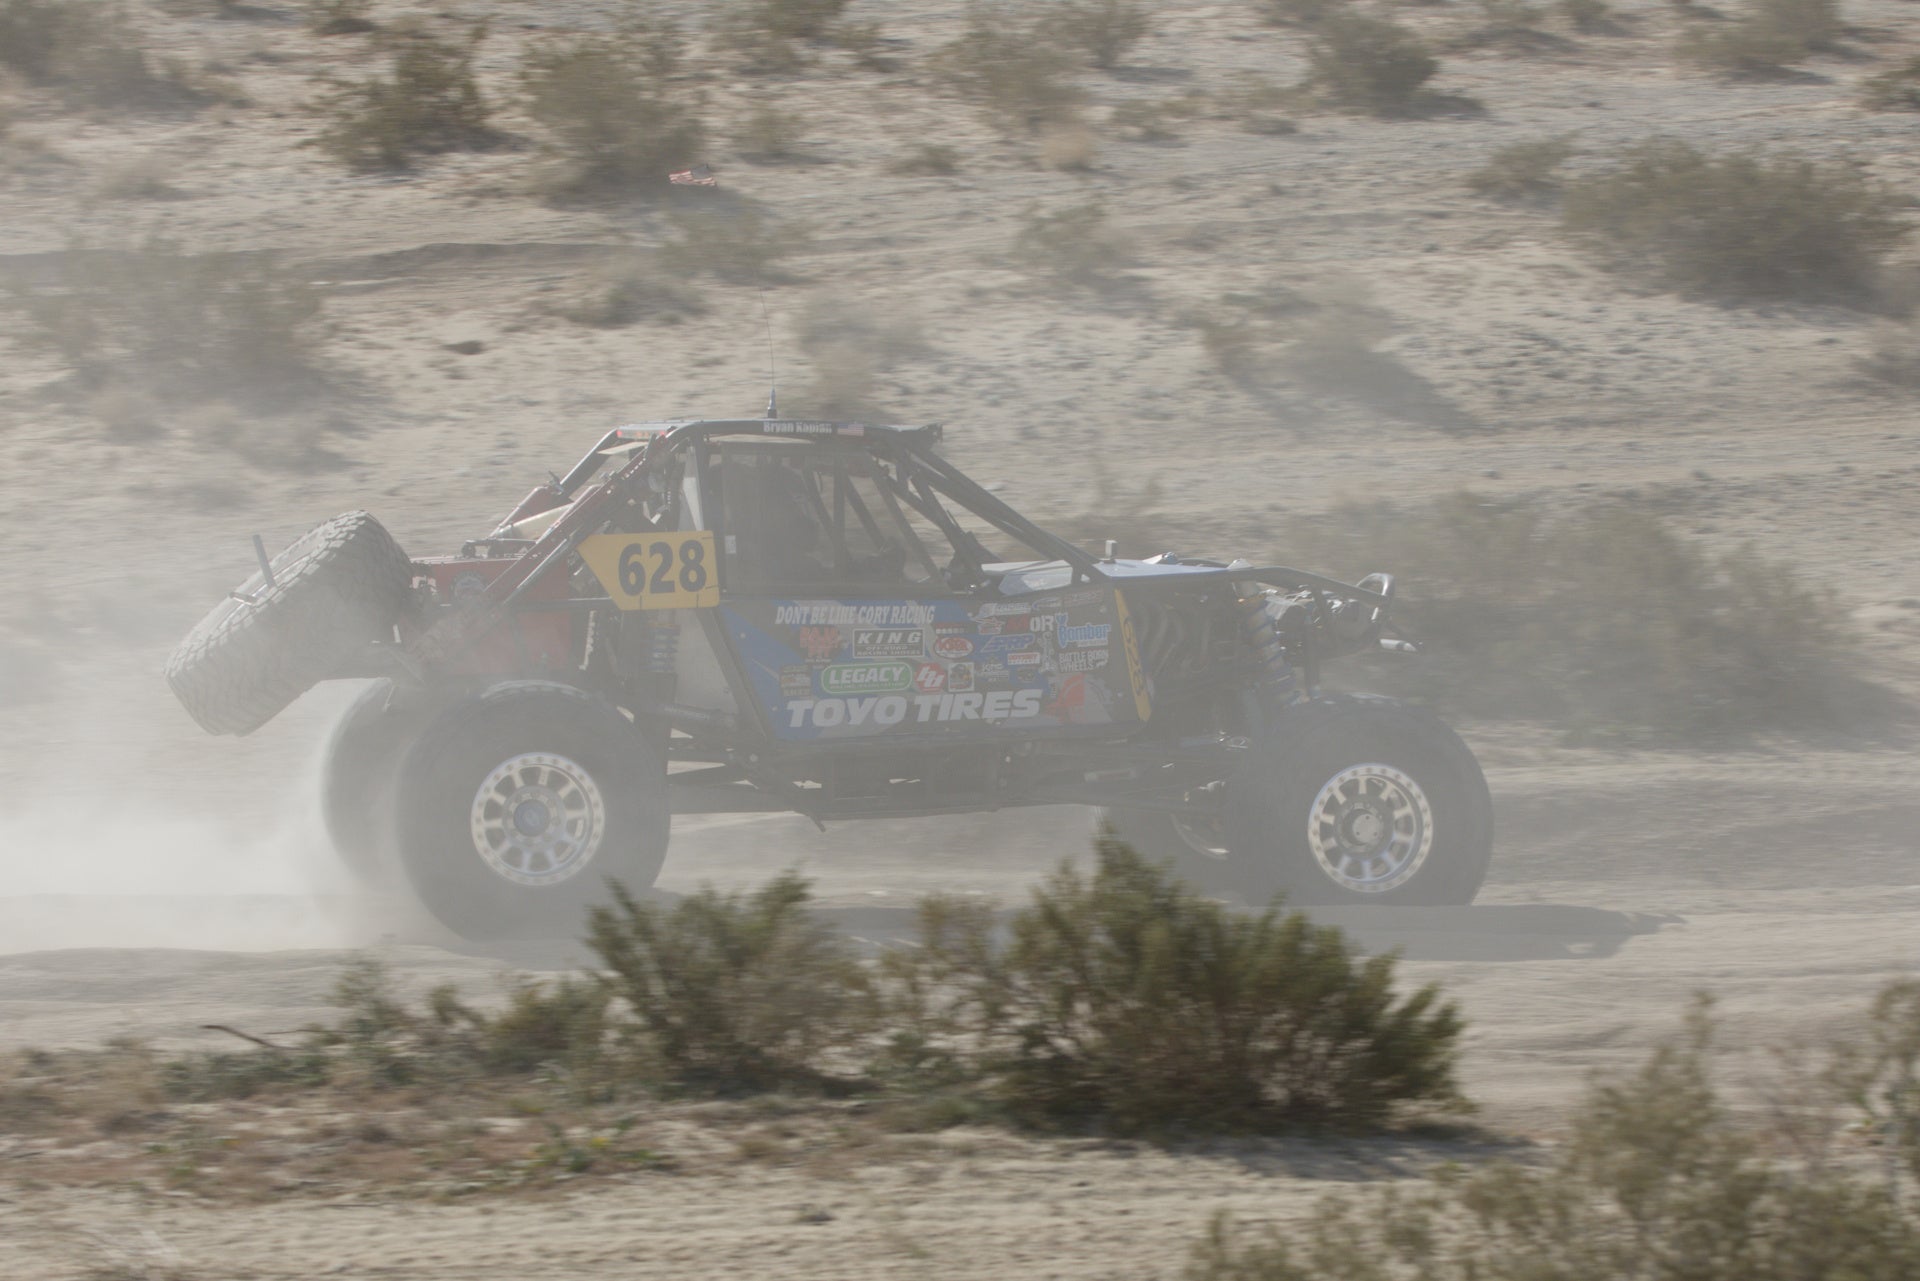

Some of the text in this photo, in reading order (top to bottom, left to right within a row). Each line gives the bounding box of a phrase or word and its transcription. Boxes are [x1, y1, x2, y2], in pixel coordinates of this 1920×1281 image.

[618, 539, 707, 596] 628
[775, 605, 936, 624] DONT BE LIKE CORY RACING
[857, 631, 922, 644] KING
[1059, 651, 1087, 663] BATTLE
[1059, 660, 1094, 672] WHEELS
[829, 666, 905, 685] LEGACY
[786, 695, 908, 728] TOYO
[914, 689, 1044, 723] TIRES
